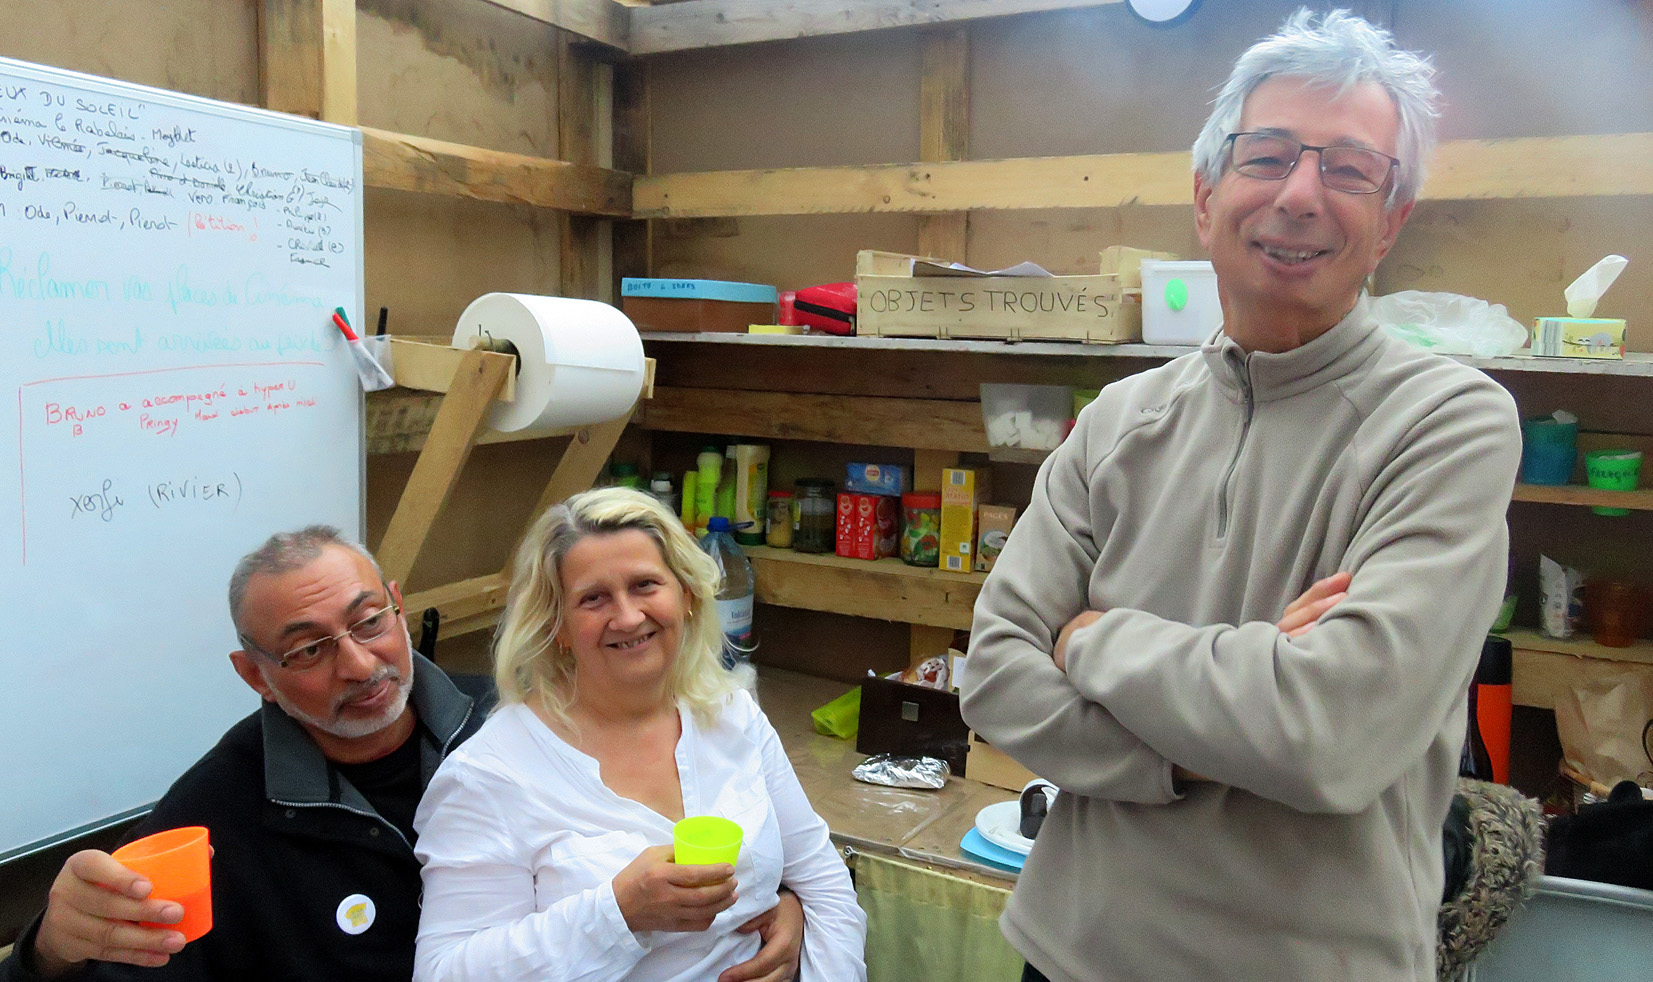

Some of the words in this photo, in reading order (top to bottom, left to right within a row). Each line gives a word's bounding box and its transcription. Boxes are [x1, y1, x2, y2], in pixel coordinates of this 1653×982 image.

[40, 90, 65, 107] DU
[0, 108, 47, 128] néma
[75, 118, 136, 142] Rabelais
[869, 289, 976, 313] OBJETS
[983, 287, 1110, 318] TROUVÉS
[96, 327, 143, 355] sont
[46, 402, 106, 425] BRUNO
[142, 382, 227, 414] accompagné
[288, 379, 296, 391] U
[73, 424, 83, 437] B
[139, 413, 179, 437] Pringy
